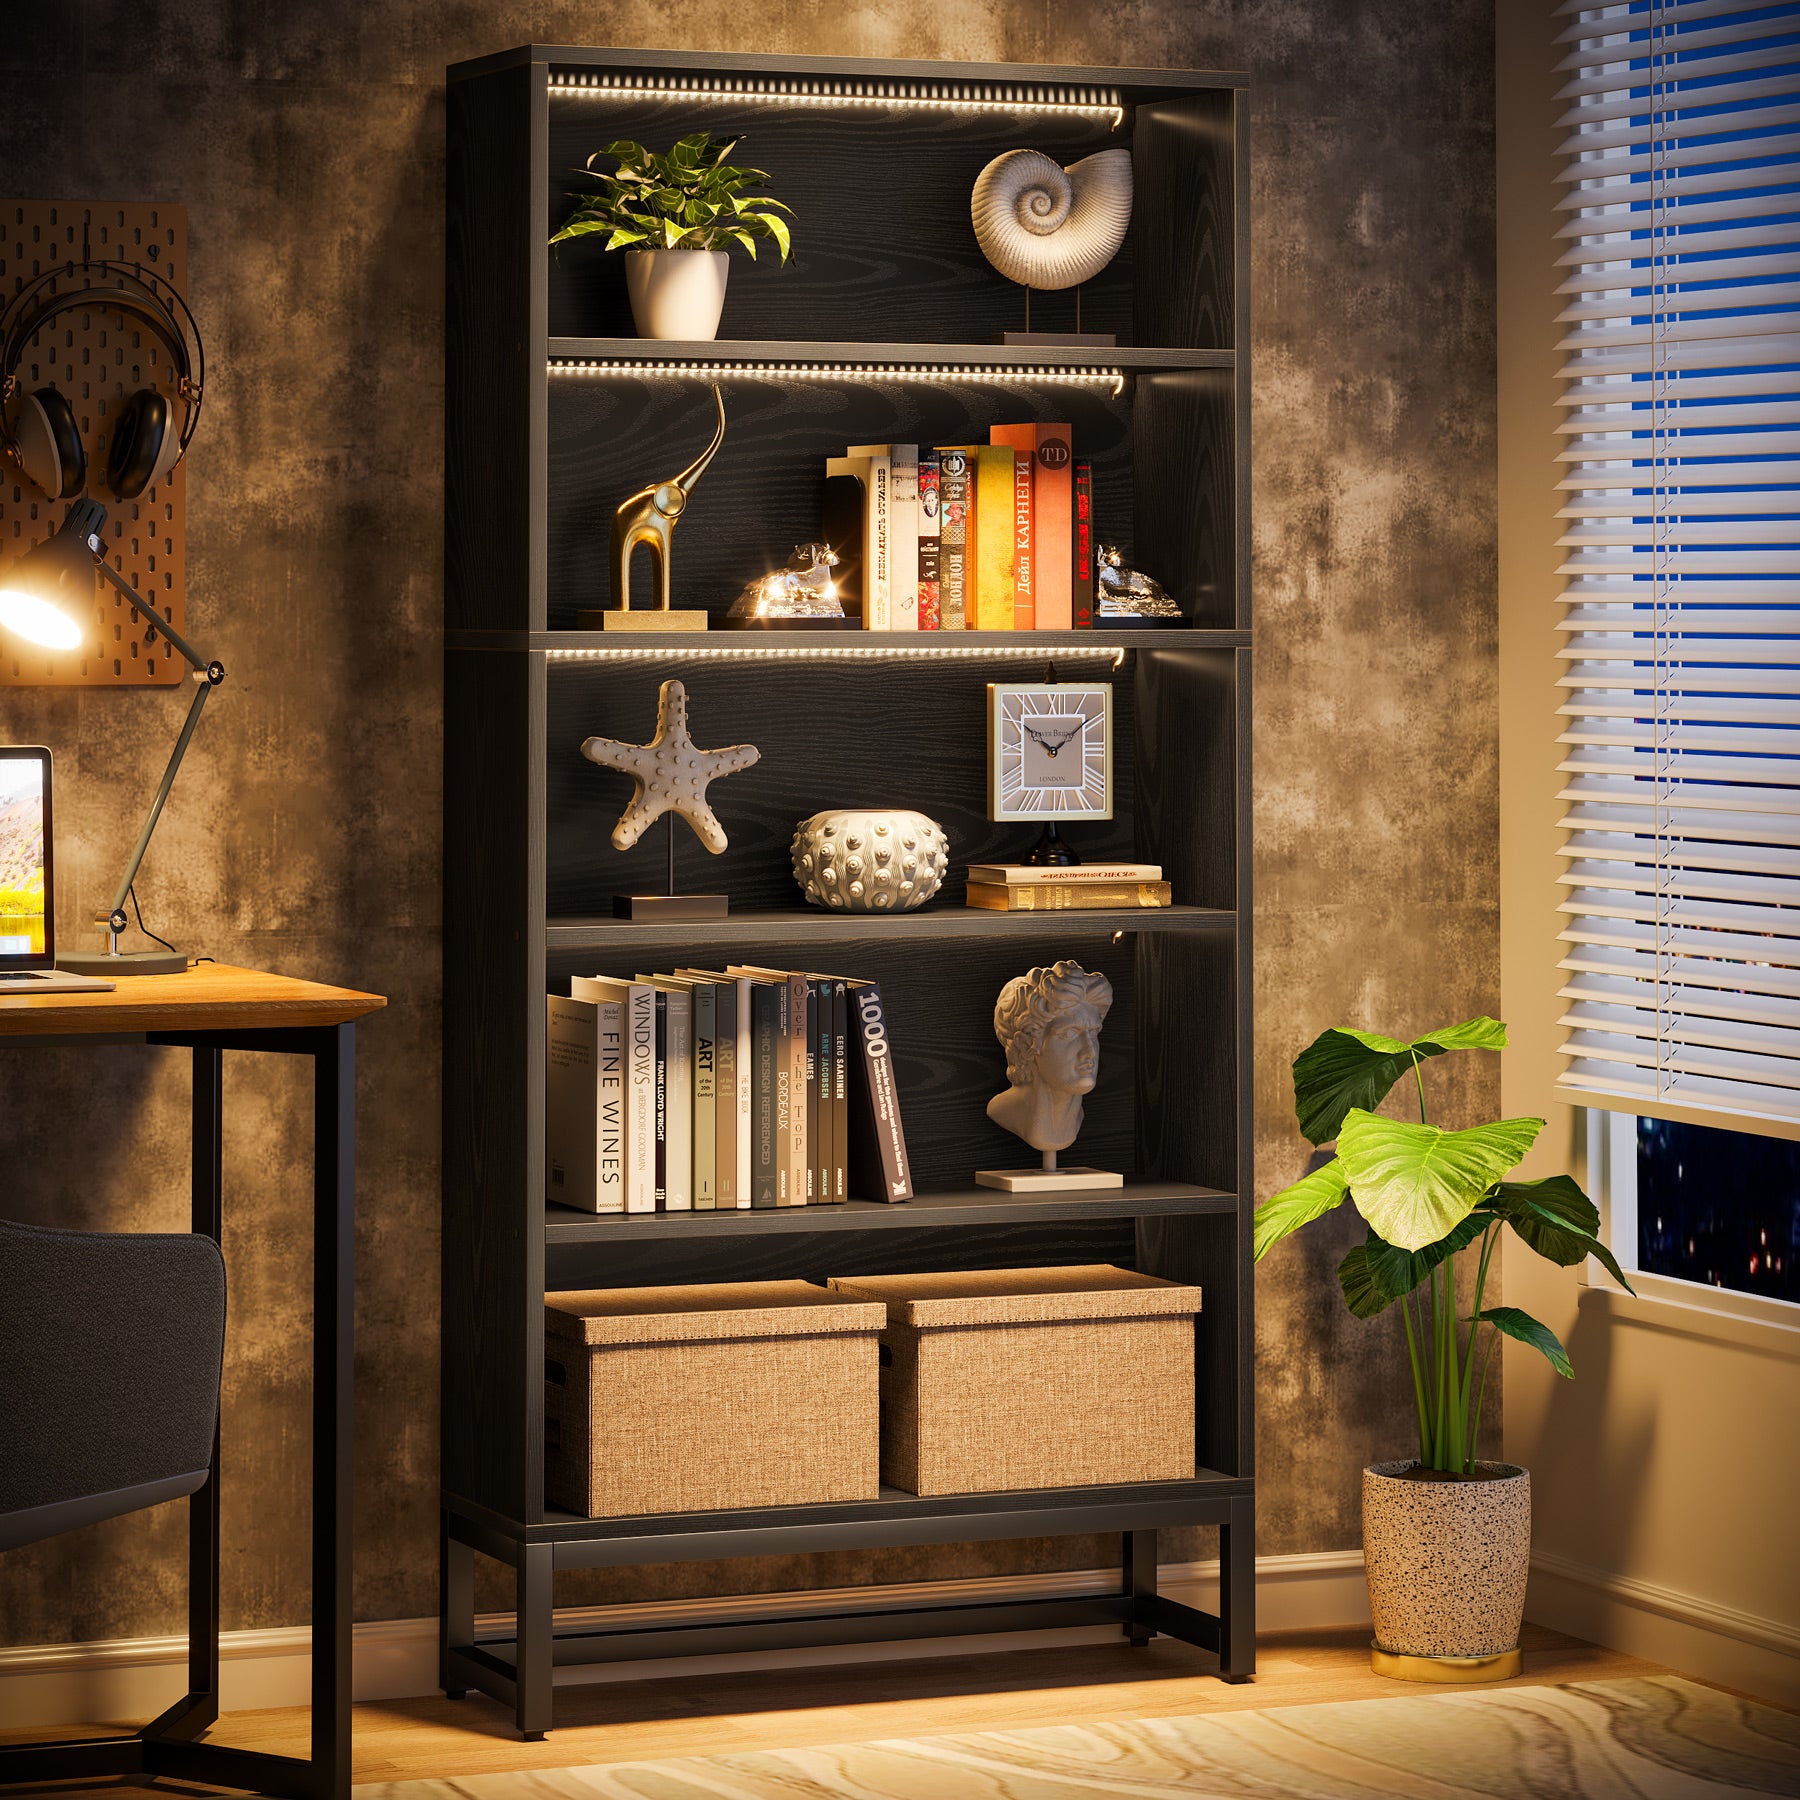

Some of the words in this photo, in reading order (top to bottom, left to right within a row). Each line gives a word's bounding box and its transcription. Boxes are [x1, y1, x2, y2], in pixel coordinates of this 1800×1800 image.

[1042, 448, 1068, 462] TD
[1017, 461, 1030, 549] КАРНЕГИ
[950, 554, 964, 606] ЛОНДОН
[1018, 556, 1031, 594] Дейл
[634, 992, 650, 1085] WINDOWS
[762, 1006, 770, 1052] GRAPHIC
[859, 992, 887, 1057] 1000
[602, 1032, 619, 1087] FINE
[699, 1038, 712, 1072] ART
[720, 1037, 733, 1072] ART
[762, 1055, 770, 1094] DESIGN
[873, 1059, 881, 1084] Geraldine
[638, 1095, 646, 1132] BERGDORF
[779, 1072, 788, 1130] BORDEAUX
[602, 1100, 619, 1183] WINES
[638, 1133, 646, 1170] GOODMAN
[762, 1097, 770, 1165] REFERENCED
